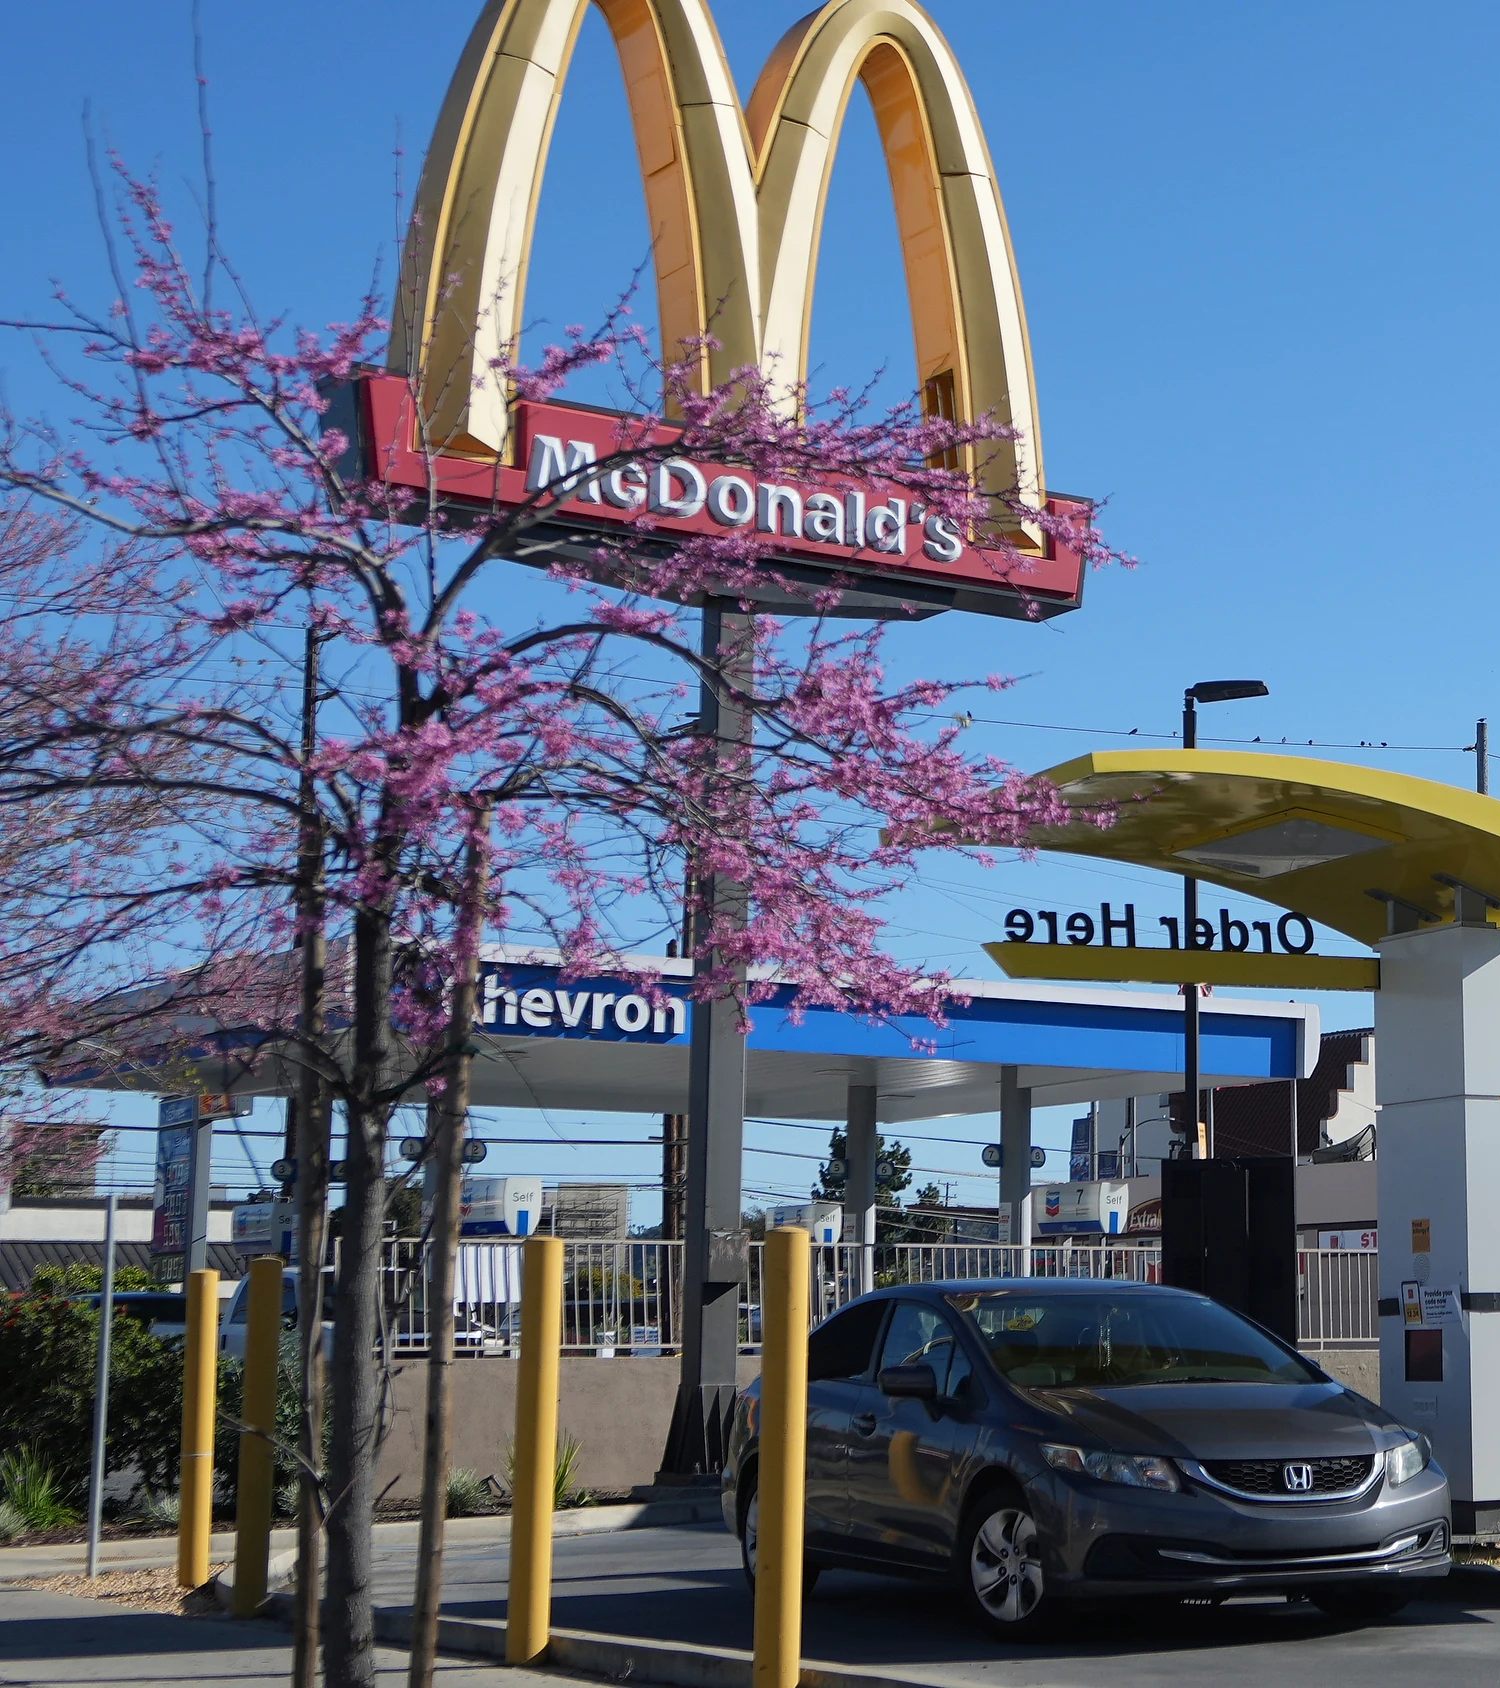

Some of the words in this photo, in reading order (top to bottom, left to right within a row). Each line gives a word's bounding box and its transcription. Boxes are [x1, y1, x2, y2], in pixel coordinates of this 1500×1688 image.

[524, 433, 964, 563] McDonald's
[988, 1150, 994, 1160] 7
[1034, 1151, 1041, 1160] 8
[278, 1164, 285, 1174] 3
[834, 1163, 840, 1172] 5
[881, 1165, 887, 1174] 6
[512, 1191, 534, 1203] Self
[1076, 1188, 1084, 1205] 7
[1105, 1195, 1123, 1205] Self
[278, 1215, 291, 1225] Se
[819, 1214, 836, 1223] Self
[1424, 1290, 1441, 1298] Provide
[1441, 1290, 1453, 1299] your
